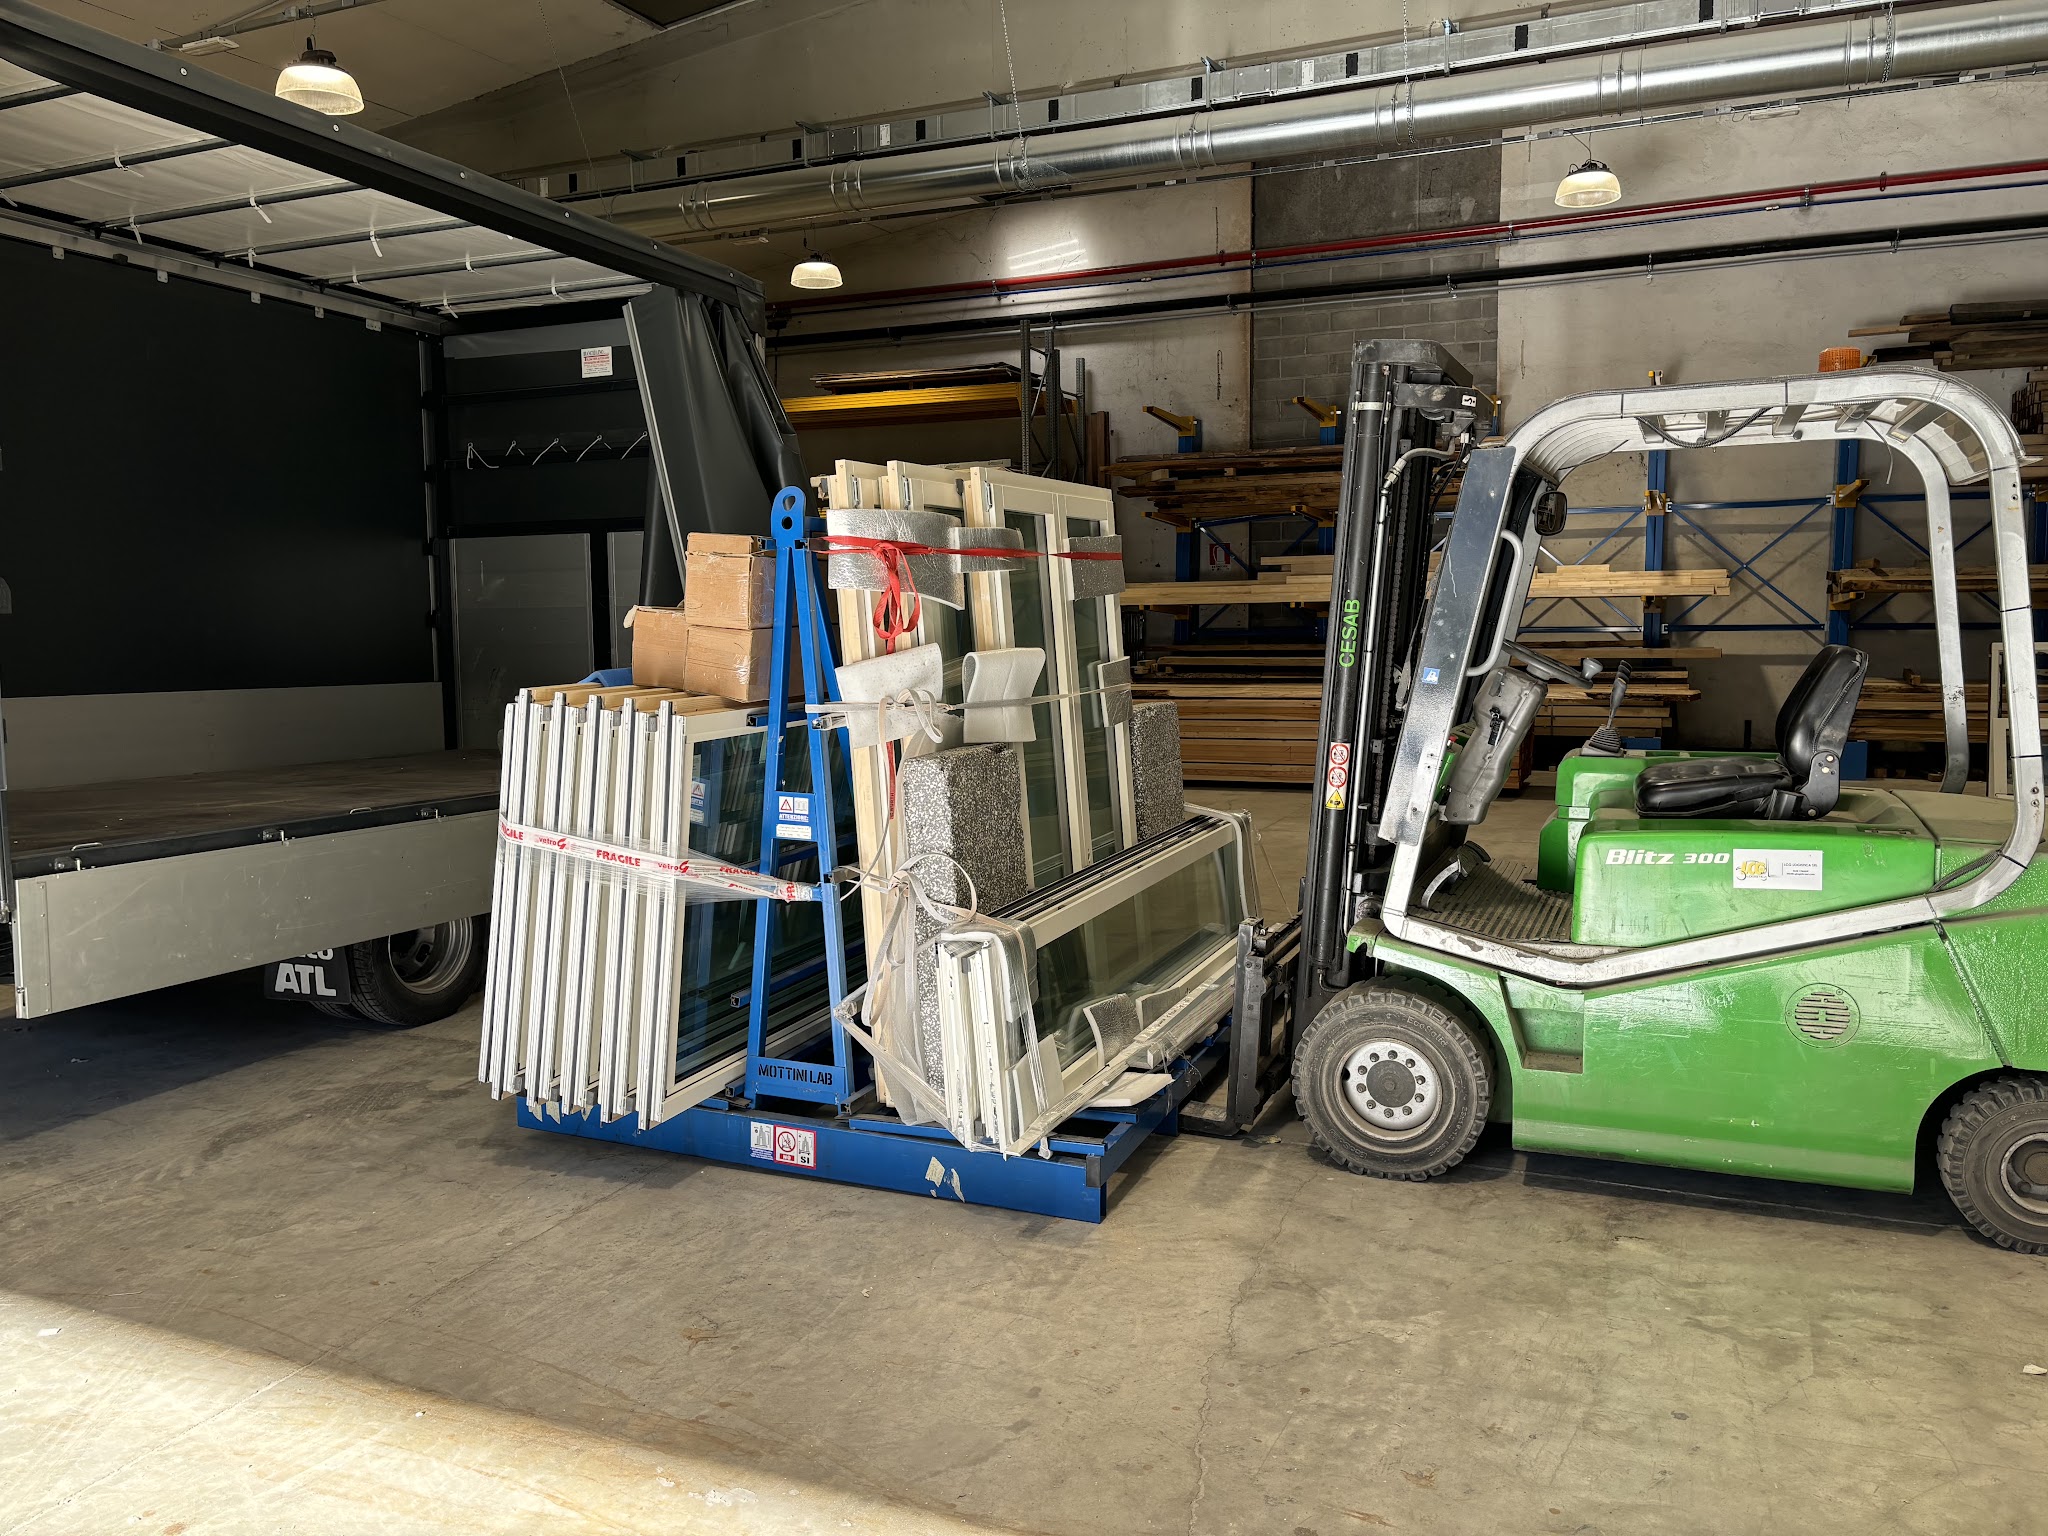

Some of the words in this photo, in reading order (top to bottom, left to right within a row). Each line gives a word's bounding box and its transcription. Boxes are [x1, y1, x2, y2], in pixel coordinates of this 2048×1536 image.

[1338, 599, 1360, 668] CESAB
[596, 849, 641, 867] FRAGILE
[1605, 848, 1675, 865] Blitz
[1682, 852, 1731, 864] 300
[274, 962, 337, 997] ATL
[758, 1063, 808, 1083] MOTTINI
[810, 1070, 833, 1086] LAB
[800, 1156, 810, 1164] SI
